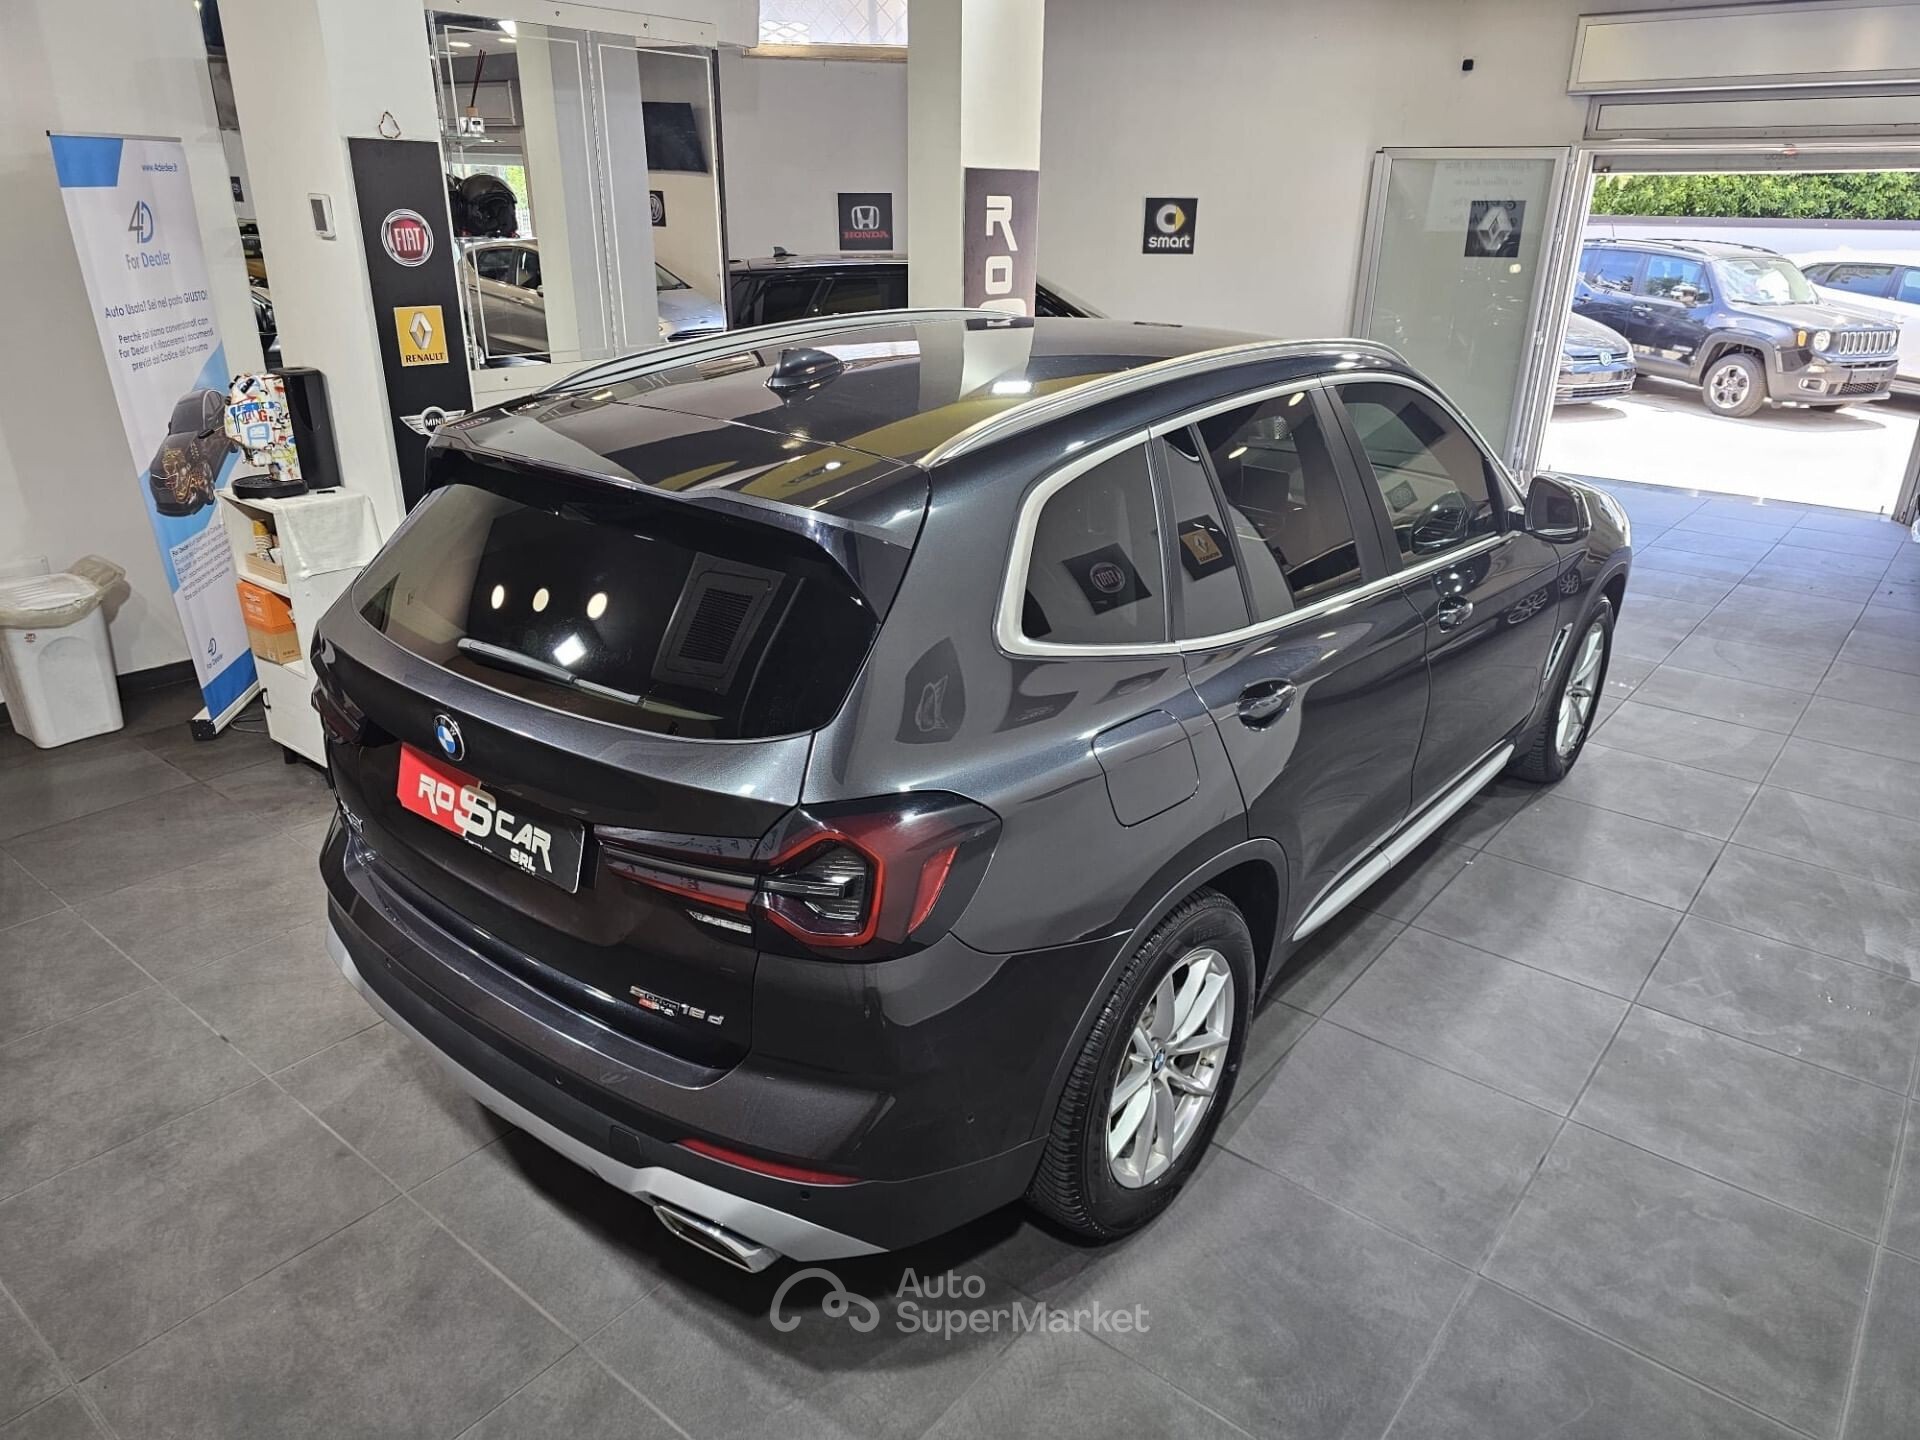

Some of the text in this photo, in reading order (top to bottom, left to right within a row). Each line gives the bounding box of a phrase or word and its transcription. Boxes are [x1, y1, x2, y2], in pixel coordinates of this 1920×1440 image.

[393, 227, 422, 251] FIAT
[844, 230, 889, 239] HONDA
[1148, 234, 1190, 248] smart
[125, 250, 172, 271] For Dealer
[105, 306, 125, 319] Auto
[405, 352, 443, 363] RENAULT
[509, 847, 536, 872] SRL
